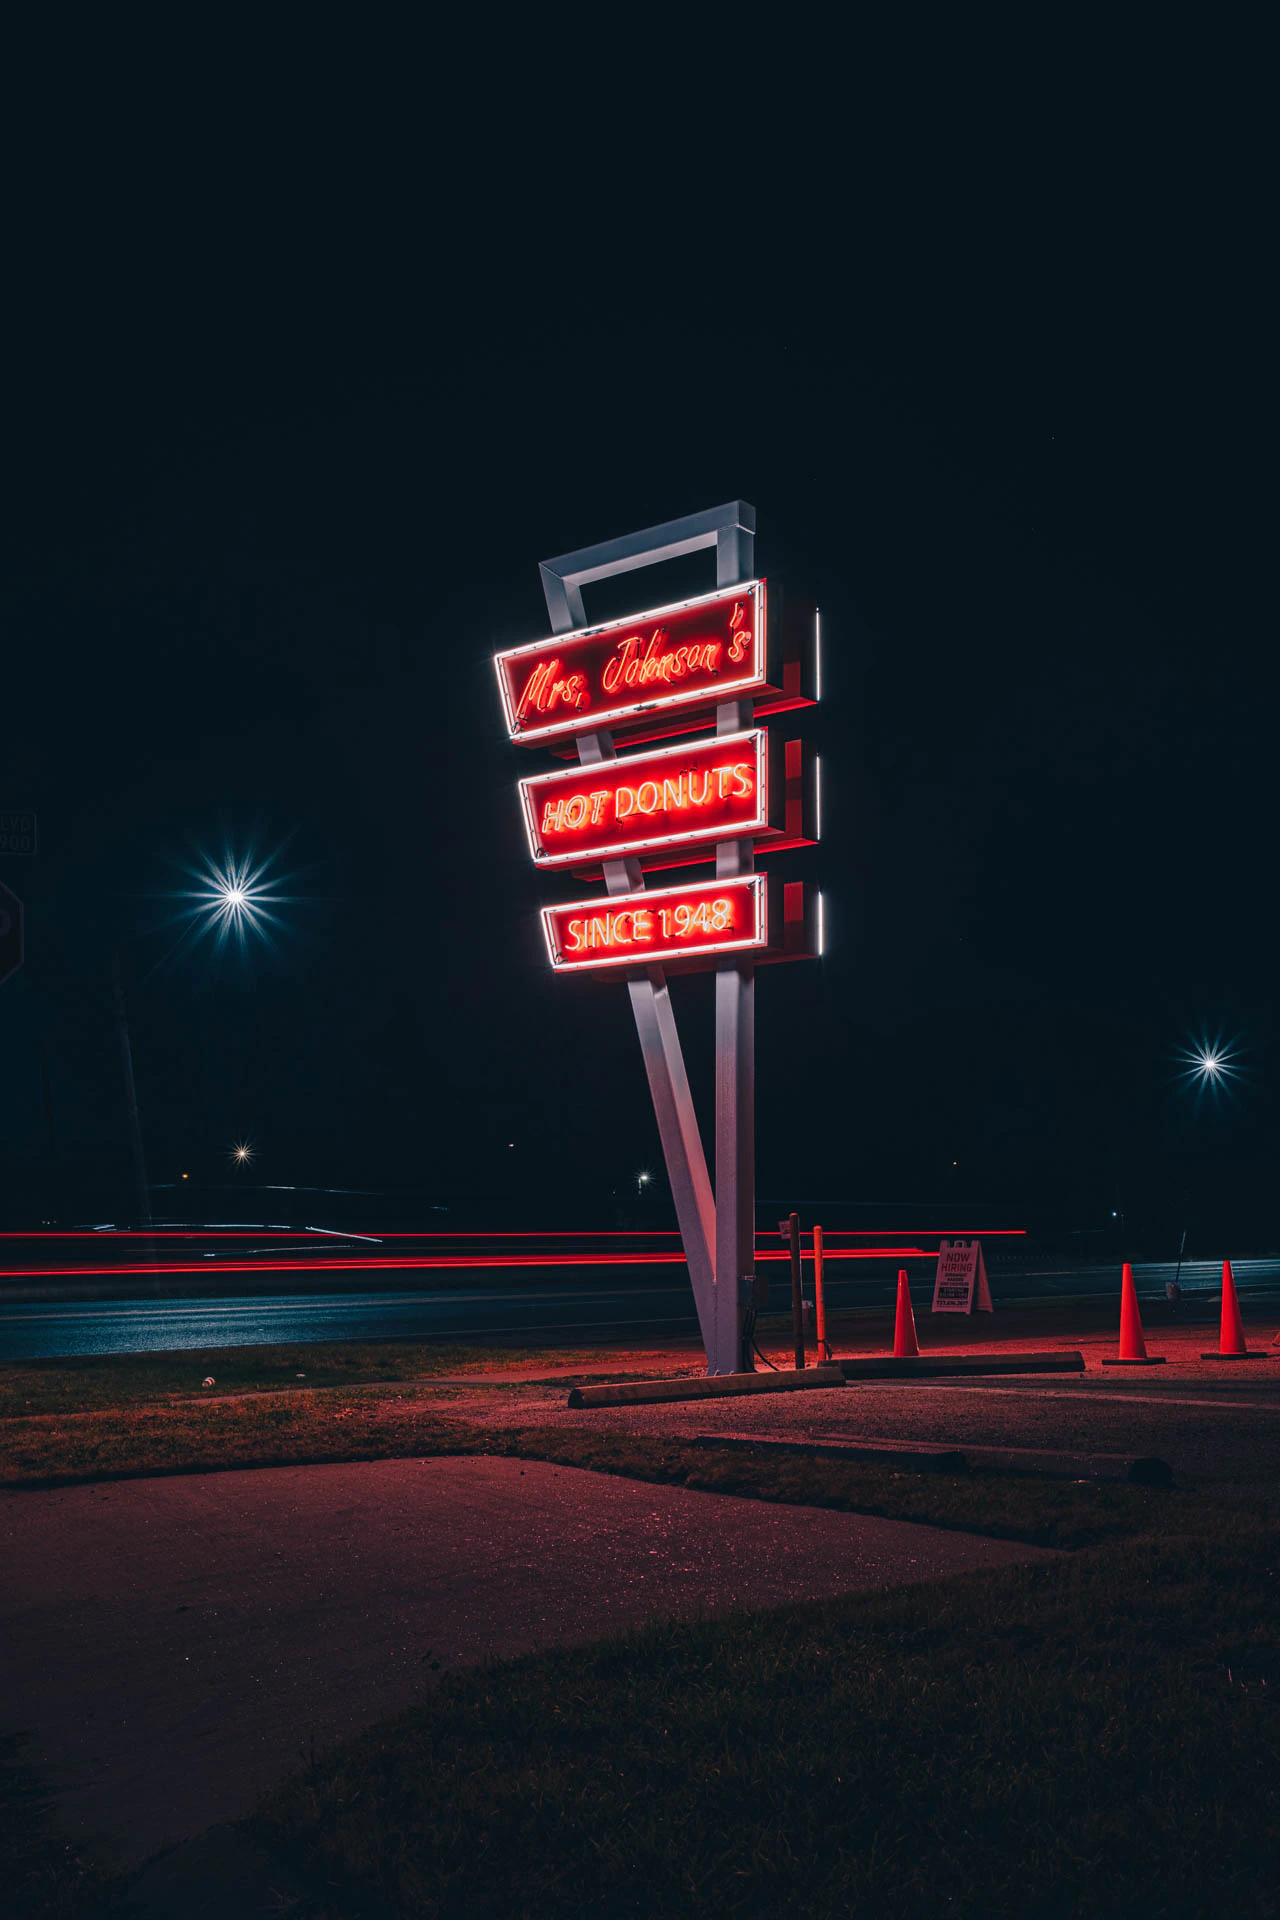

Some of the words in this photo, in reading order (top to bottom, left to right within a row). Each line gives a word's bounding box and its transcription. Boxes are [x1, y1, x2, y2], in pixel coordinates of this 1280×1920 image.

[602, 602, 752, 693] Johnson's
[542, 790, 608, 834] HOT
[614, 763, 753, 821] DONUTS
[564, 909, 652, 951] SINCE
[658, 900, 732, 938] 1948
[941, 1263, 973, 1272] HIRING
[946, 1252, 970, 1262] NOW
